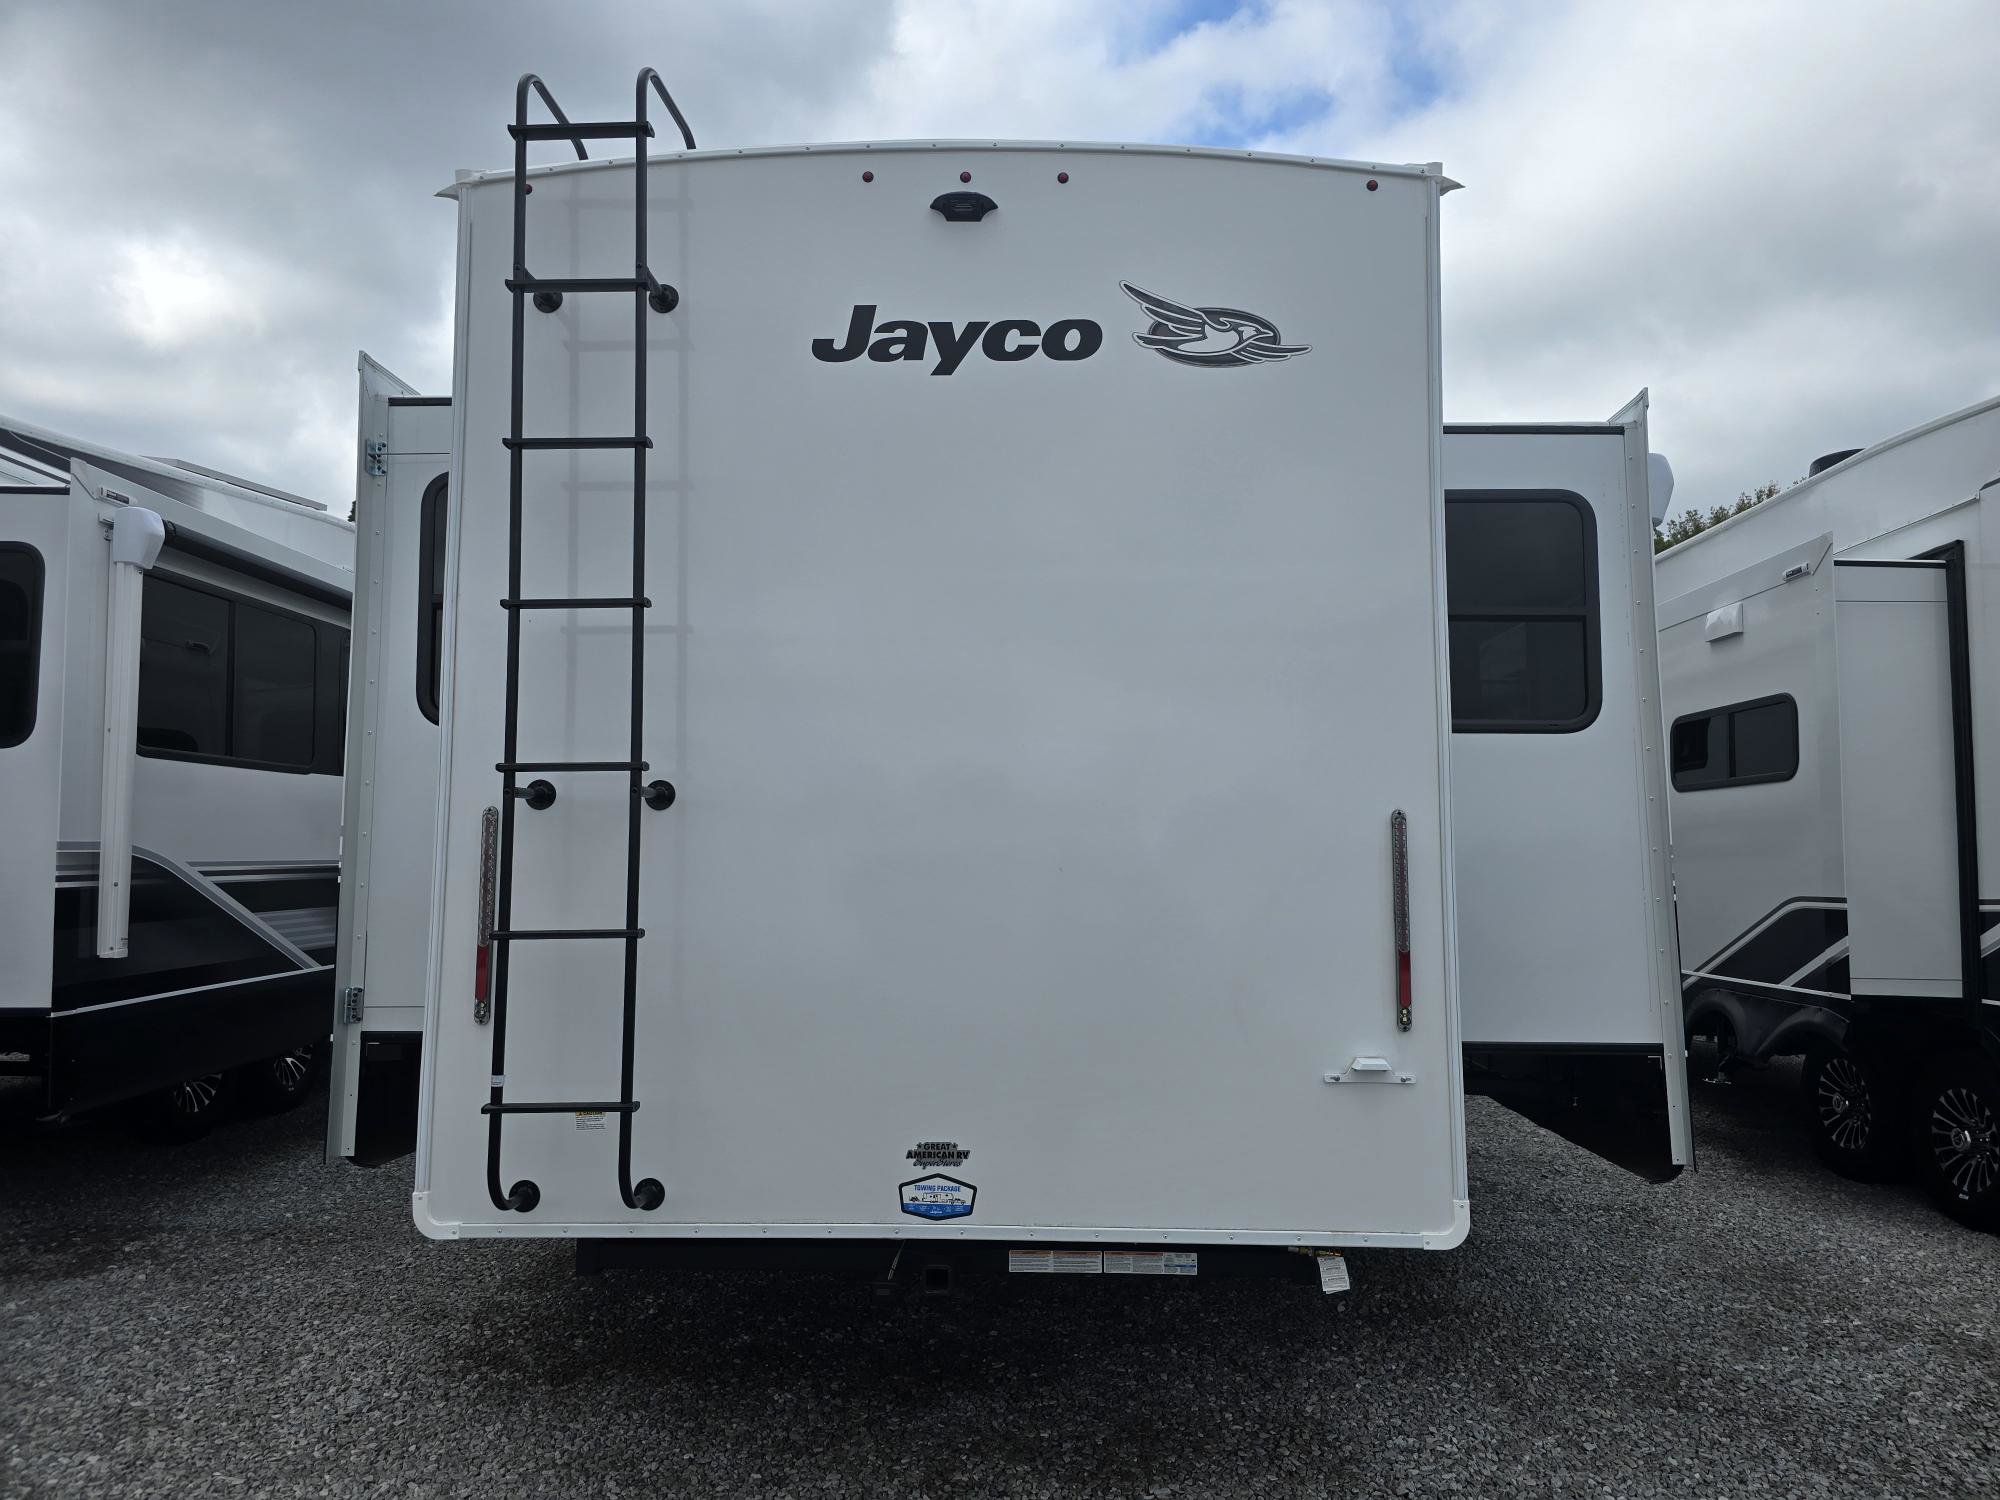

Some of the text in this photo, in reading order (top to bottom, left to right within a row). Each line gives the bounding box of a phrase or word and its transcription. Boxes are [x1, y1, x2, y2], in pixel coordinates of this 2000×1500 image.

[811, 304, 1103, 376] Jayco
[906, 1150, 970, 1159] AMERICAN RV
[914, 1184, 936, 1192] TOWING
